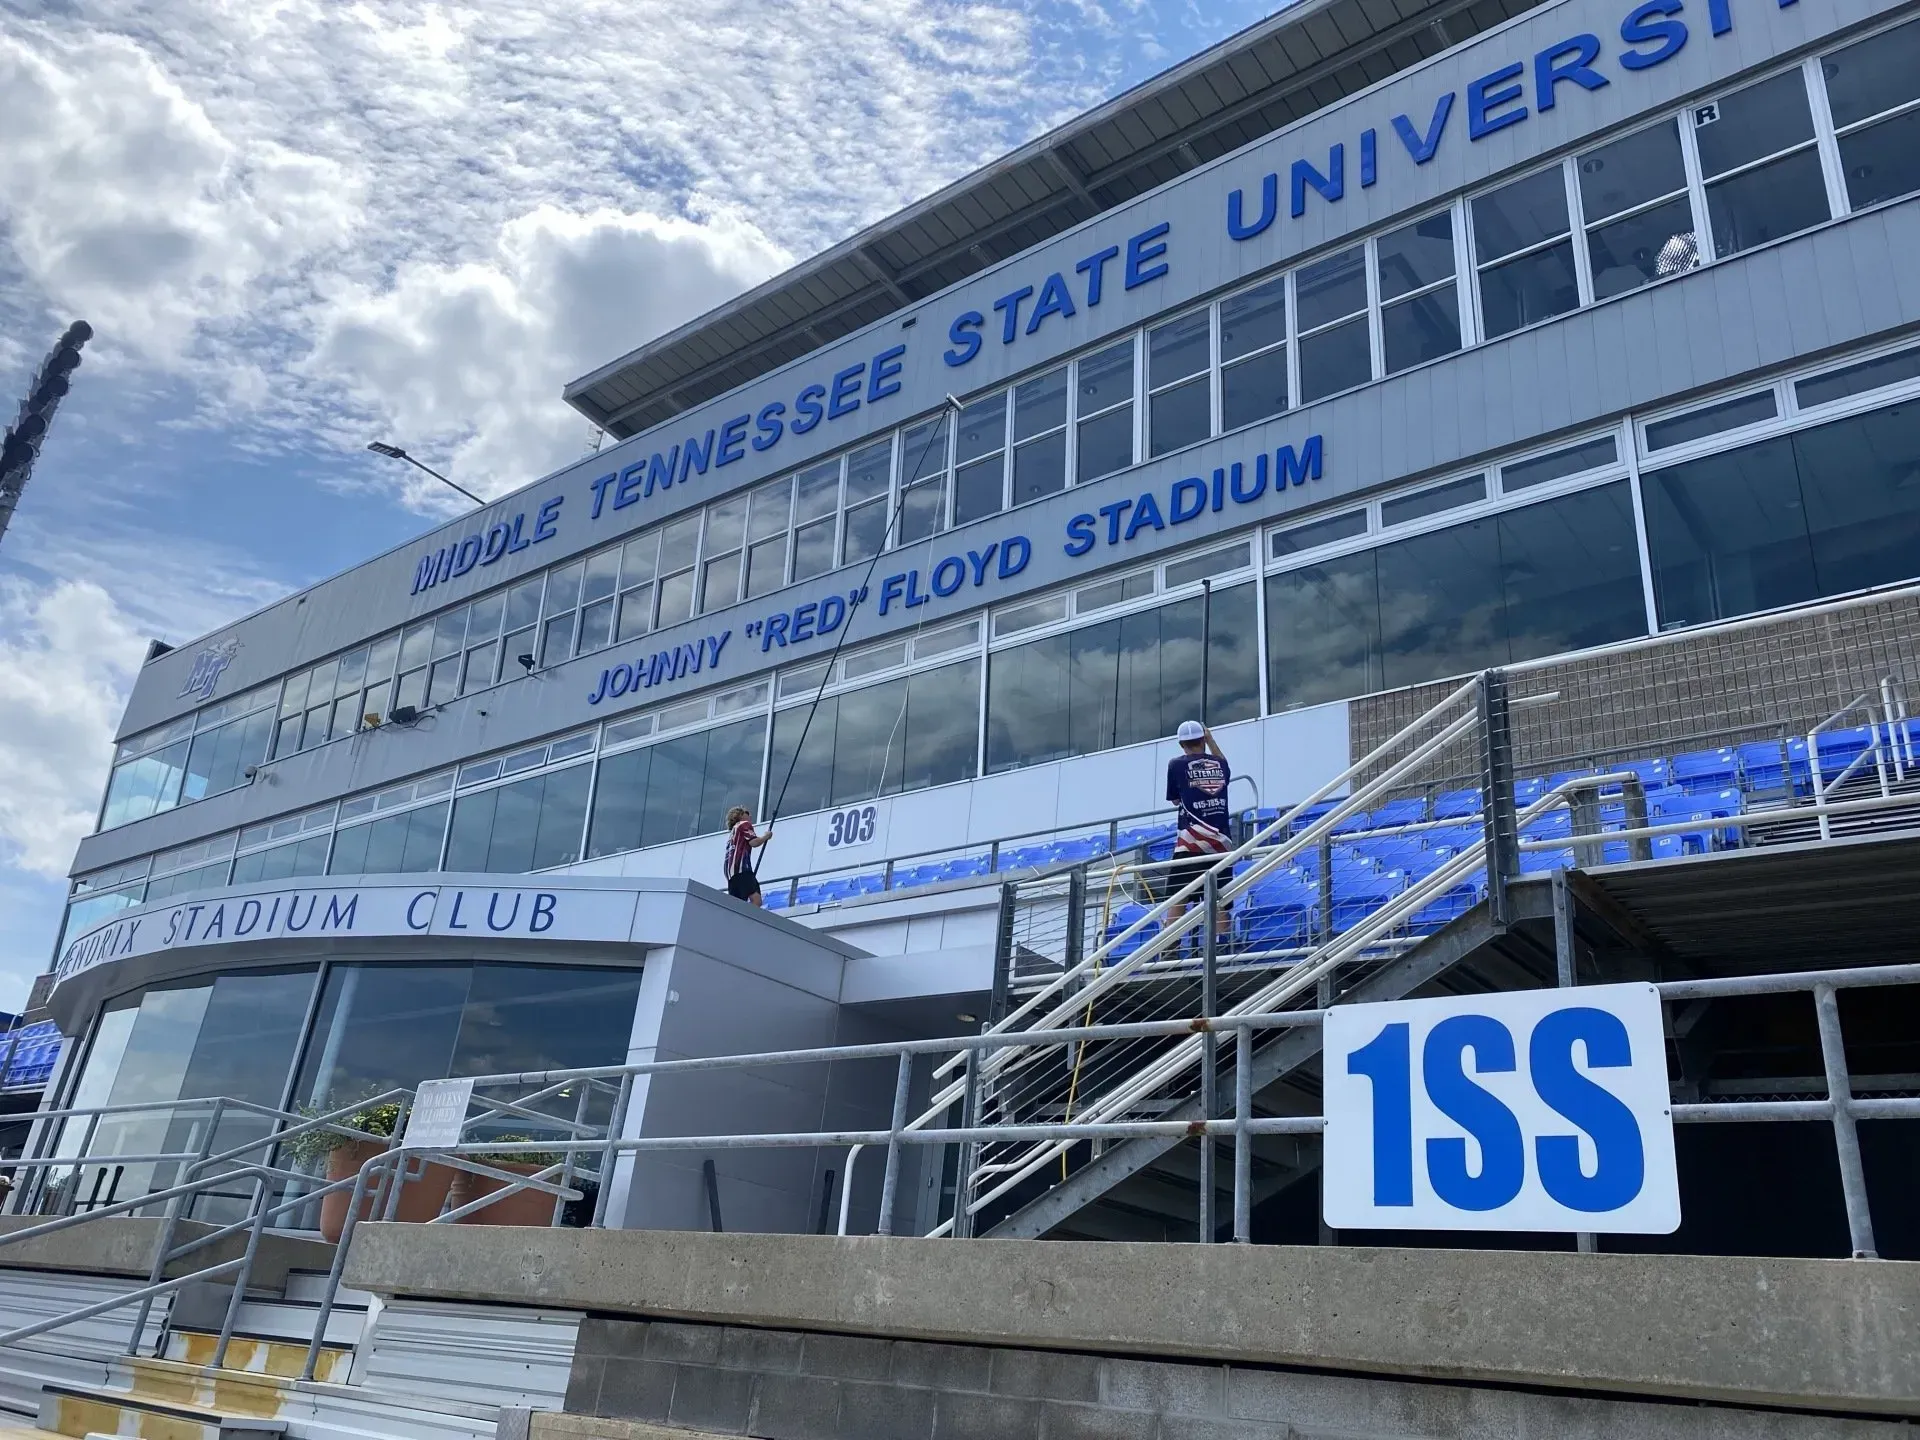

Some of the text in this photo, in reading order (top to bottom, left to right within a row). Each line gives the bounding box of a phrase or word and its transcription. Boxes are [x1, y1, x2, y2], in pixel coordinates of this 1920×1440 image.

[1695, 105, 1717, 126] R
[410, 495, 564, 595] MIDDLE
[589, 344, 905, 519] TENNESSEE
[942, 222, 1170, 367] STATE
[587, 630, 731, 705] JOHNNY
[878, 534, 1032, 615] FLOYD
[1063, 434, 1324, 557] STADIUM
[828, 806, 876, 847] 303
[163, 892, 360, 946] STADIUM
[406, 889, 559, 934] CLUB
[1347, 1007, 1645, 1213] 1SS
